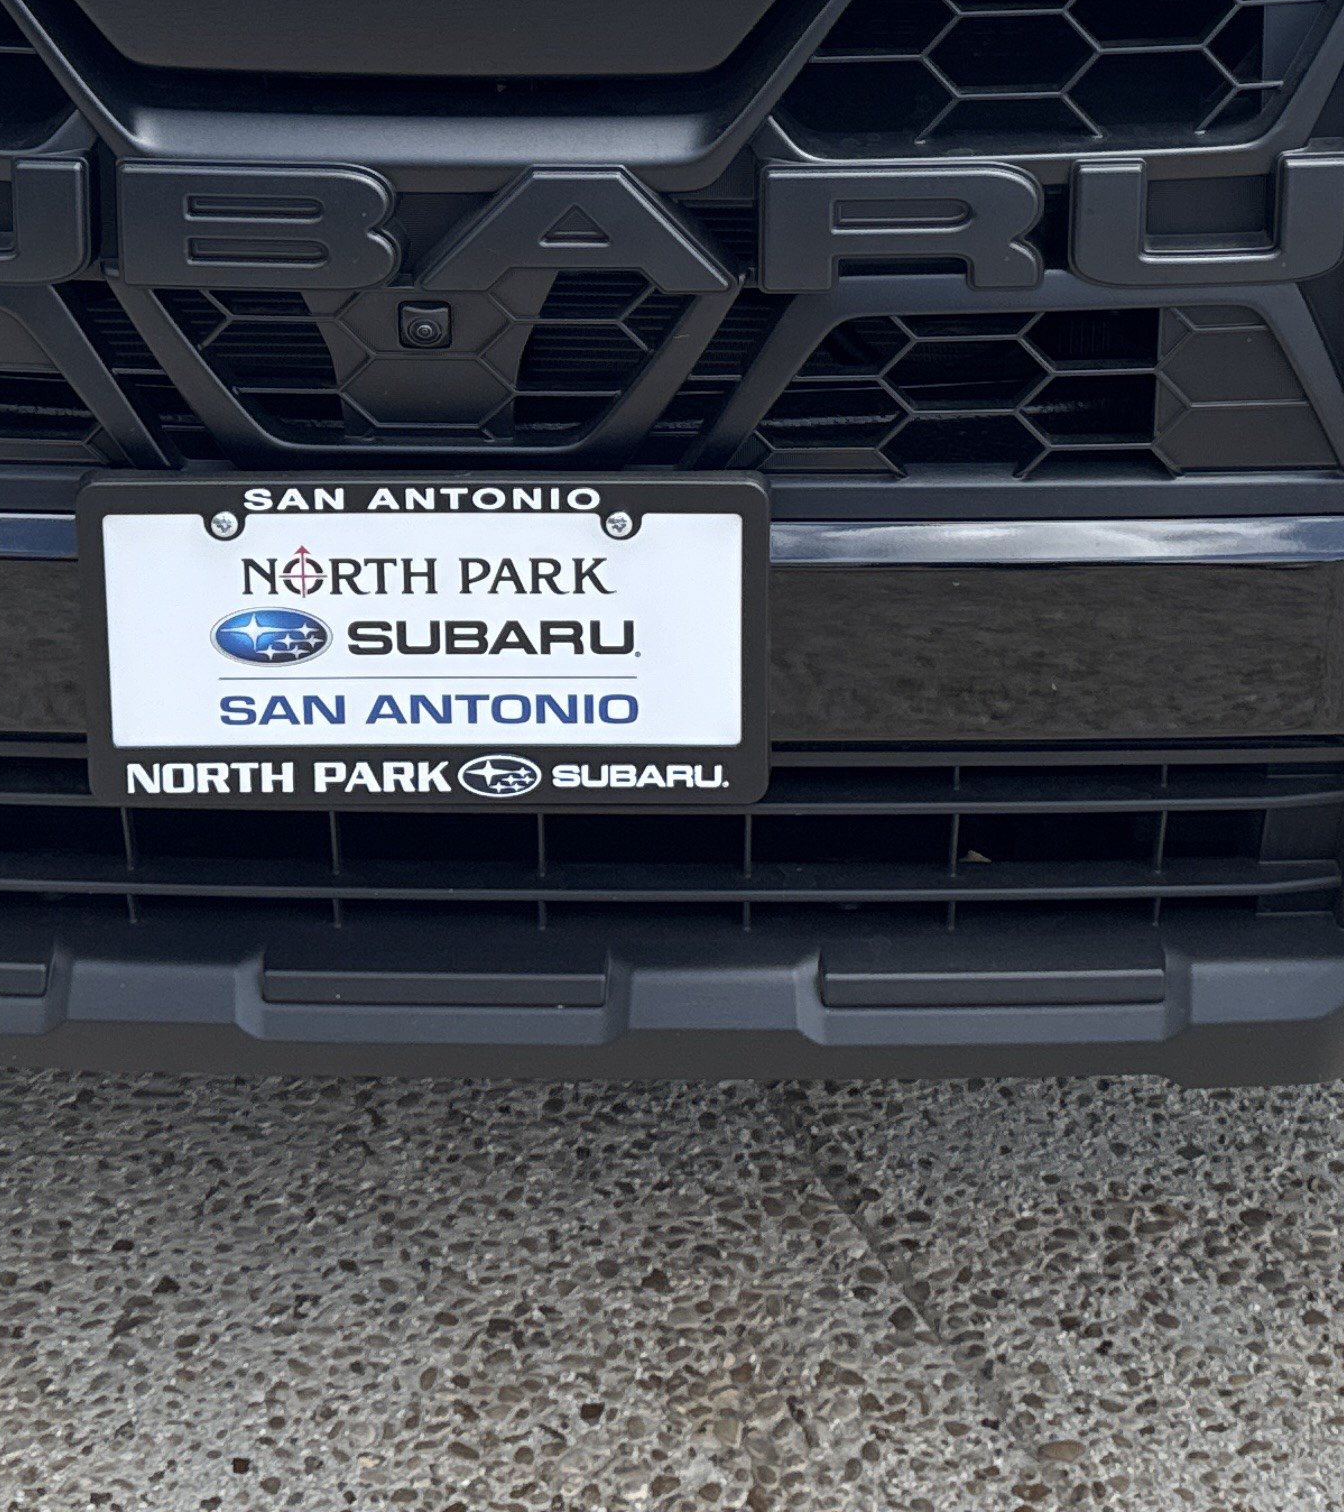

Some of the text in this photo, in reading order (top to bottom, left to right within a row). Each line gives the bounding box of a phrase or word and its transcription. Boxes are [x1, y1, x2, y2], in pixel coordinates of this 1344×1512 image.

[244, 487, 601, 510] SAN ANTONIO
[241, 557, 618, 596] NORTH PARK
[219, 694, 640, 726] SAN ANTONIO
[126, 761, 294, 794] NORTH
[313, 760, 452, 793] PARK
